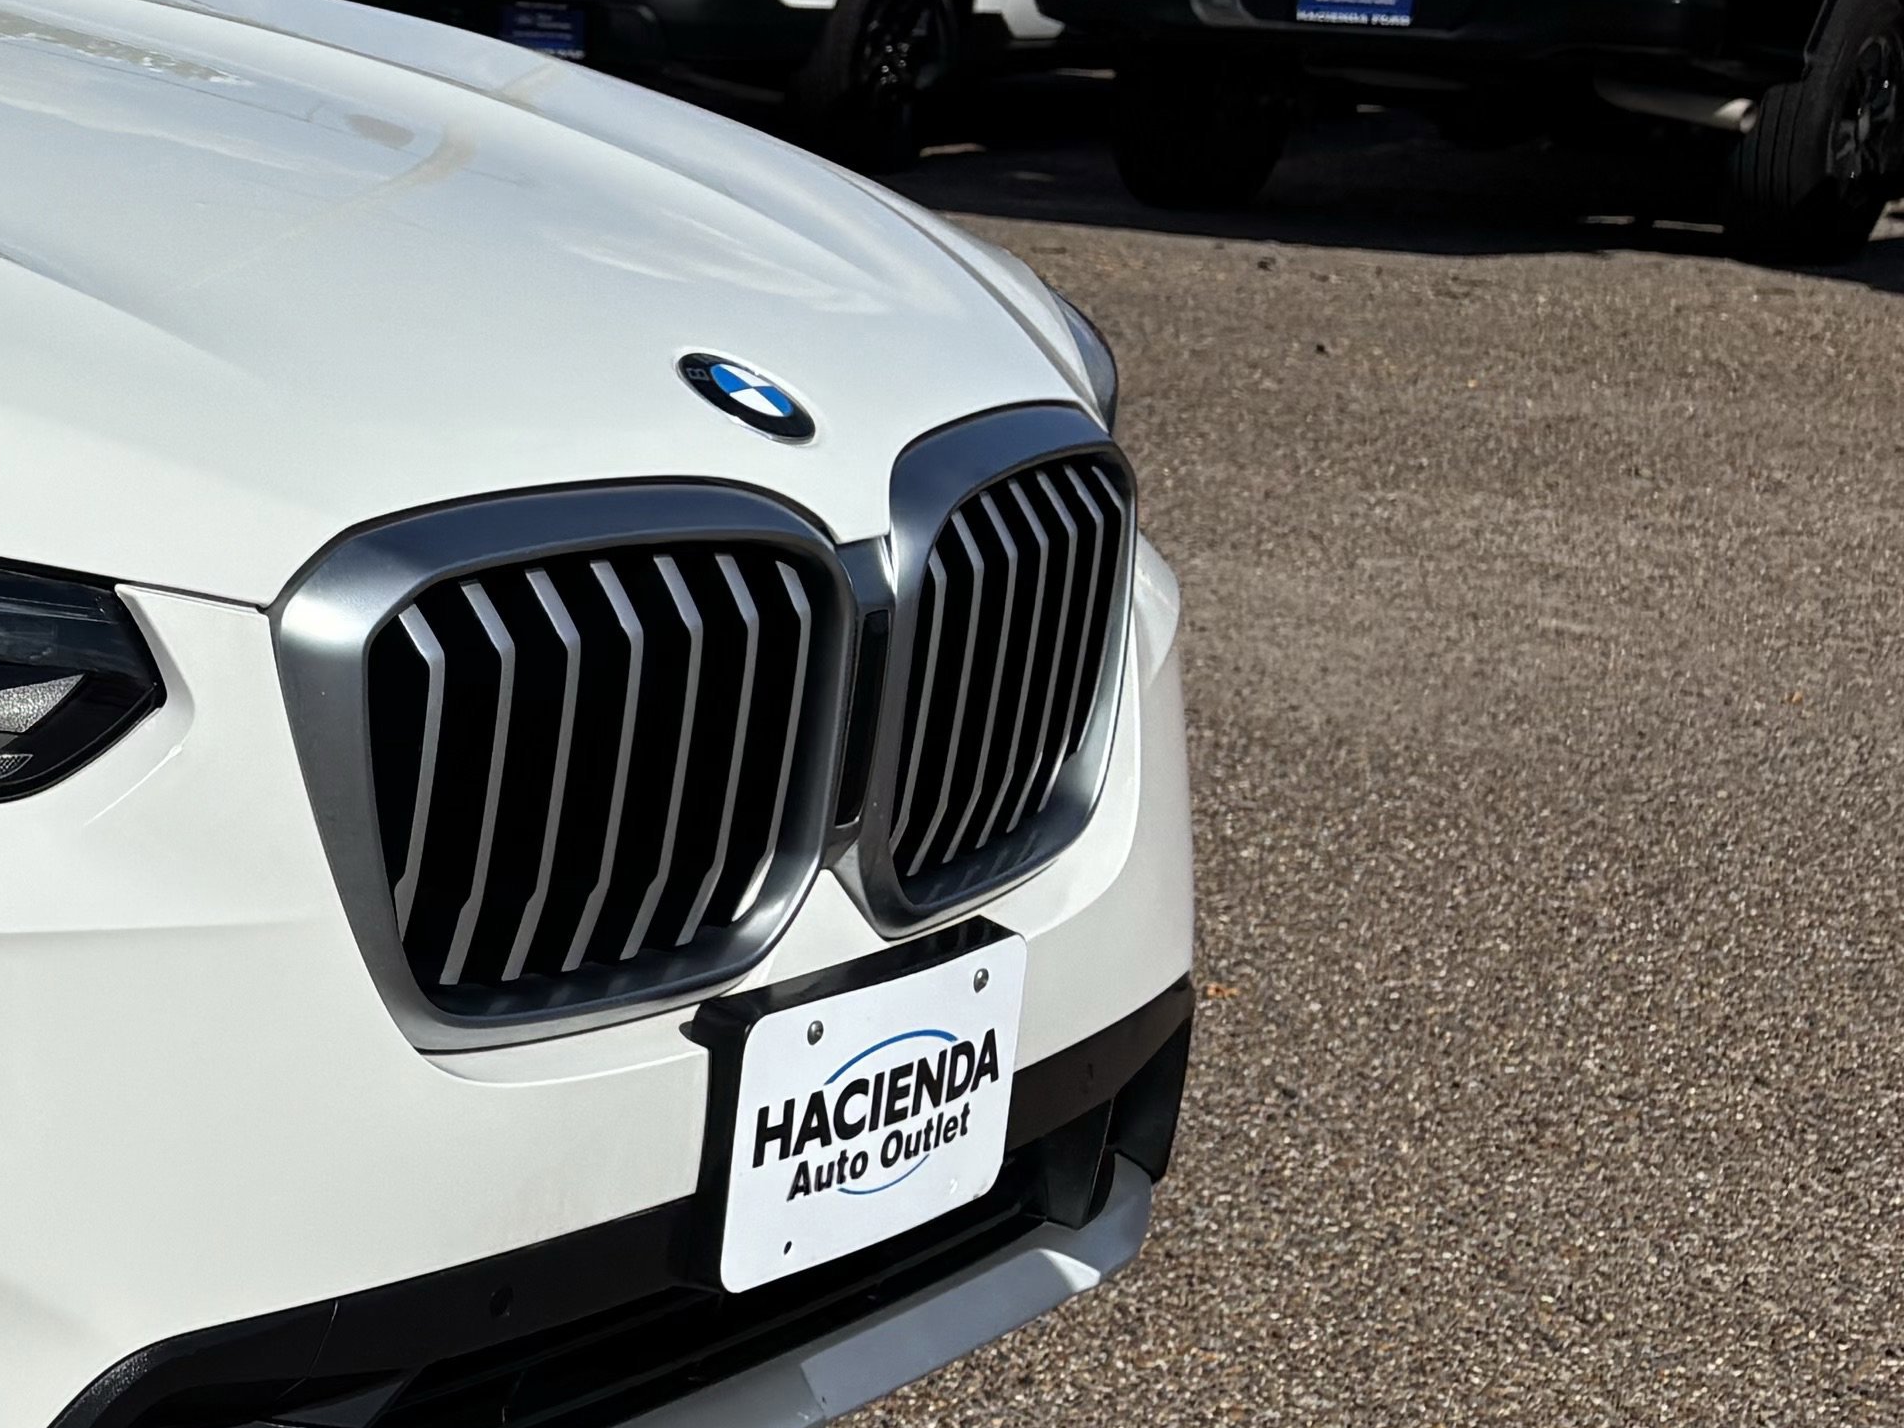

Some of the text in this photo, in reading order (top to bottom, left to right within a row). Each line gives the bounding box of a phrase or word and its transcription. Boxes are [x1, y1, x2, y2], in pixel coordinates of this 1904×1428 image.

[752, 1028, 999, 1169] HACIENDA
[786, 1102, 971, 1202] Auto Outlet
